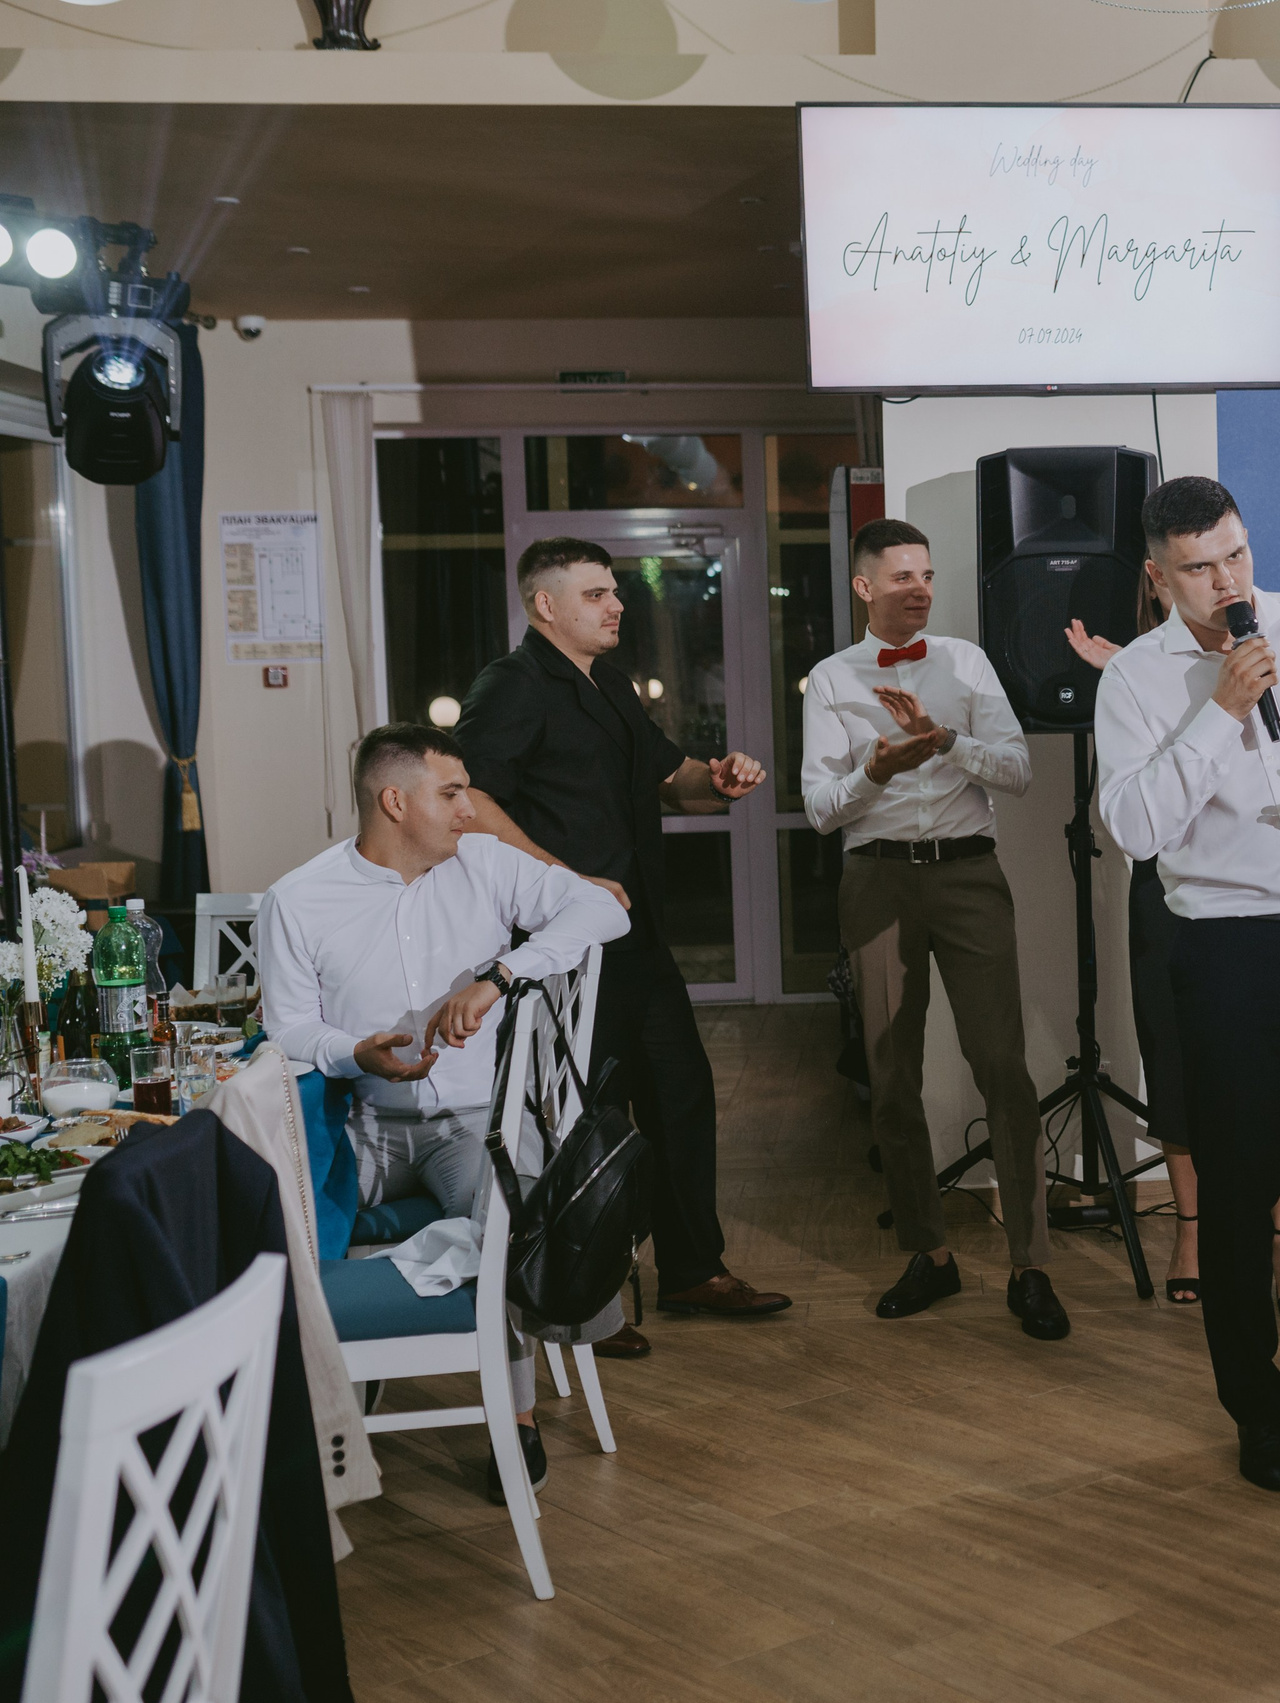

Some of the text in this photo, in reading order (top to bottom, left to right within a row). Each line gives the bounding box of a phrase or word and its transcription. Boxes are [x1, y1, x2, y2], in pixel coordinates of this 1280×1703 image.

[990, 143, 1098, 187] Wedding day
[1010, 235, 1031, 267] &
[1047, 213, 1256, 301] Margarita
[1018, 327, 1083, 344] 07.09.2024
[222, 515, 251, 525] ПЛАН
